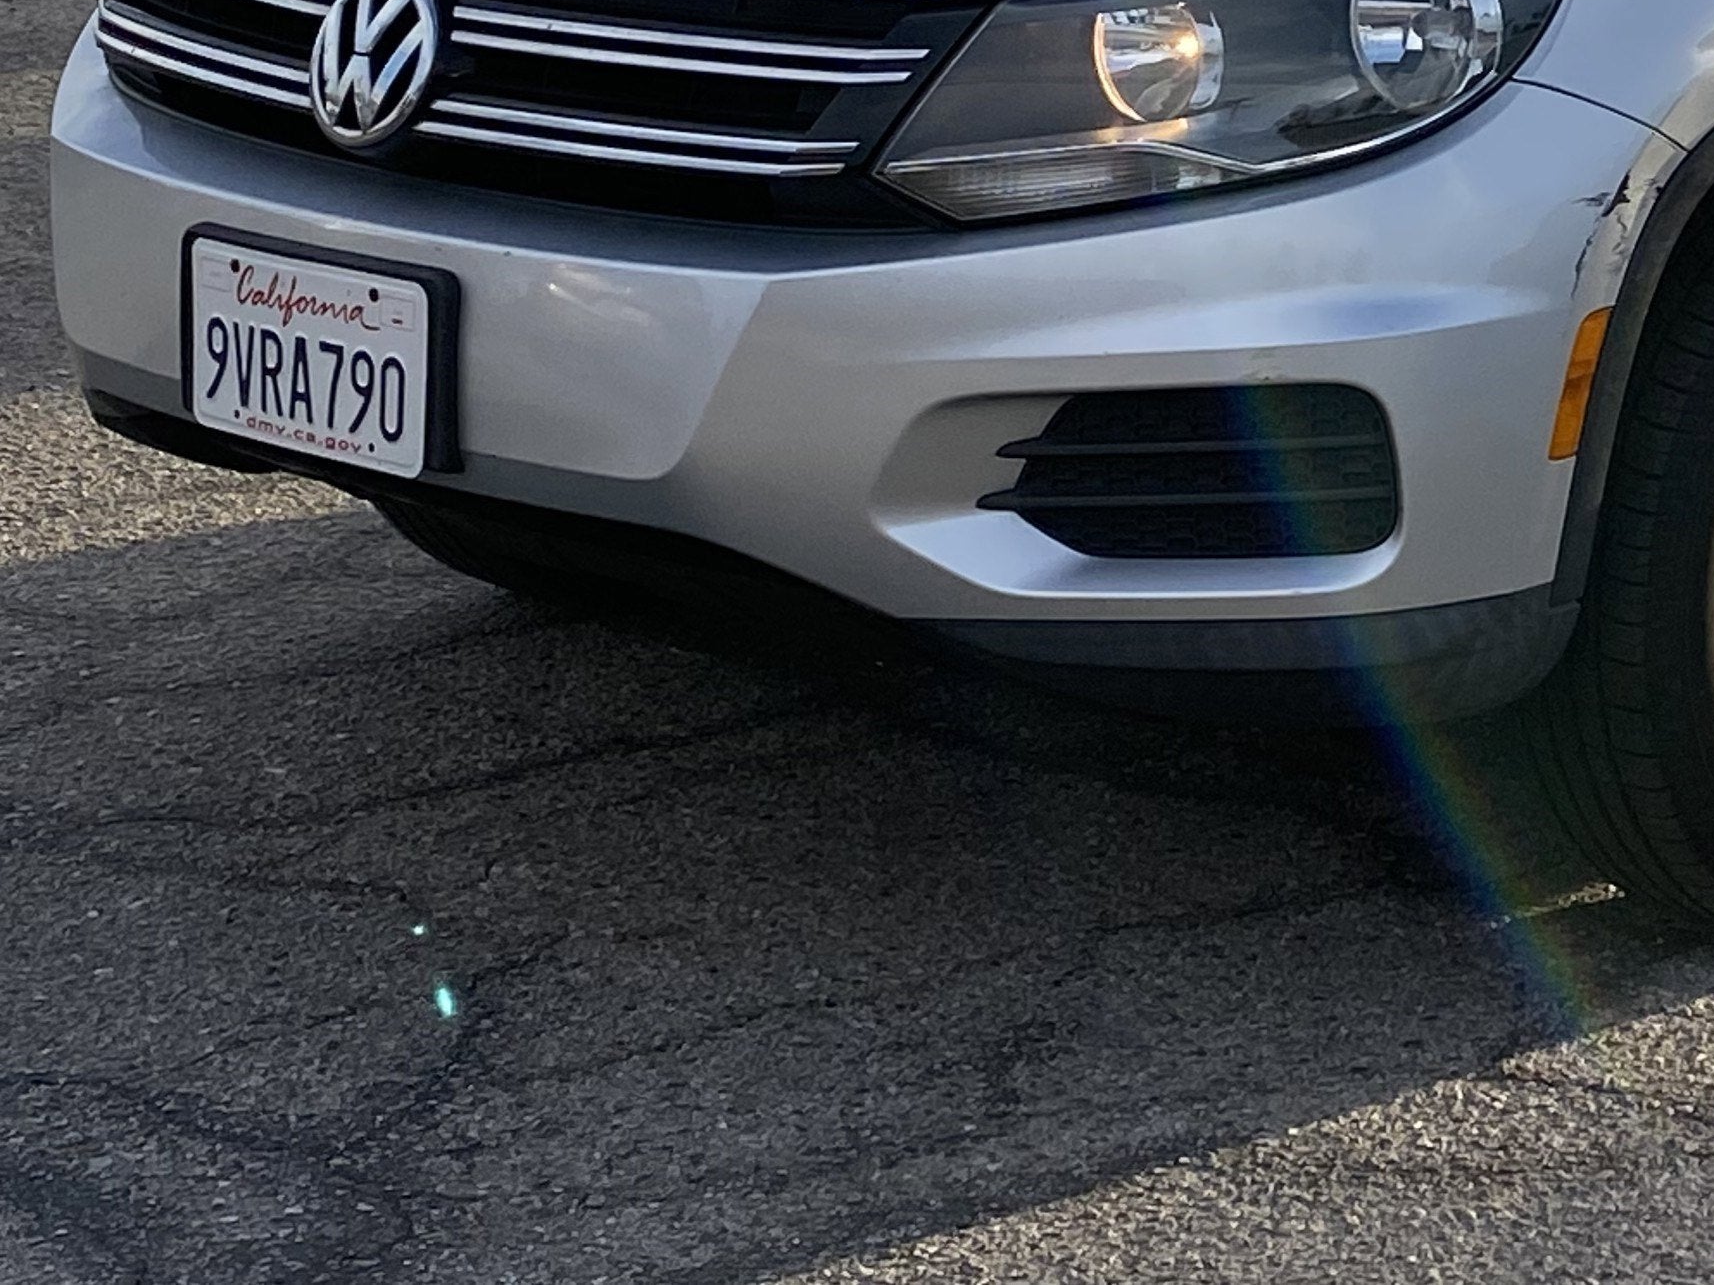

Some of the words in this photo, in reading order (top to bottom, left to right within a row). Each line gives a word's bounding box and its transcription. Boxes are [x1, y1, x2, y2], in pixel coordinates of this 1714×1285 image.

[236, 264, 380, 331] California
[206, 316, 405, 442] 9VRA790
[246, 415, 362, 452] dmv.ca.gov
